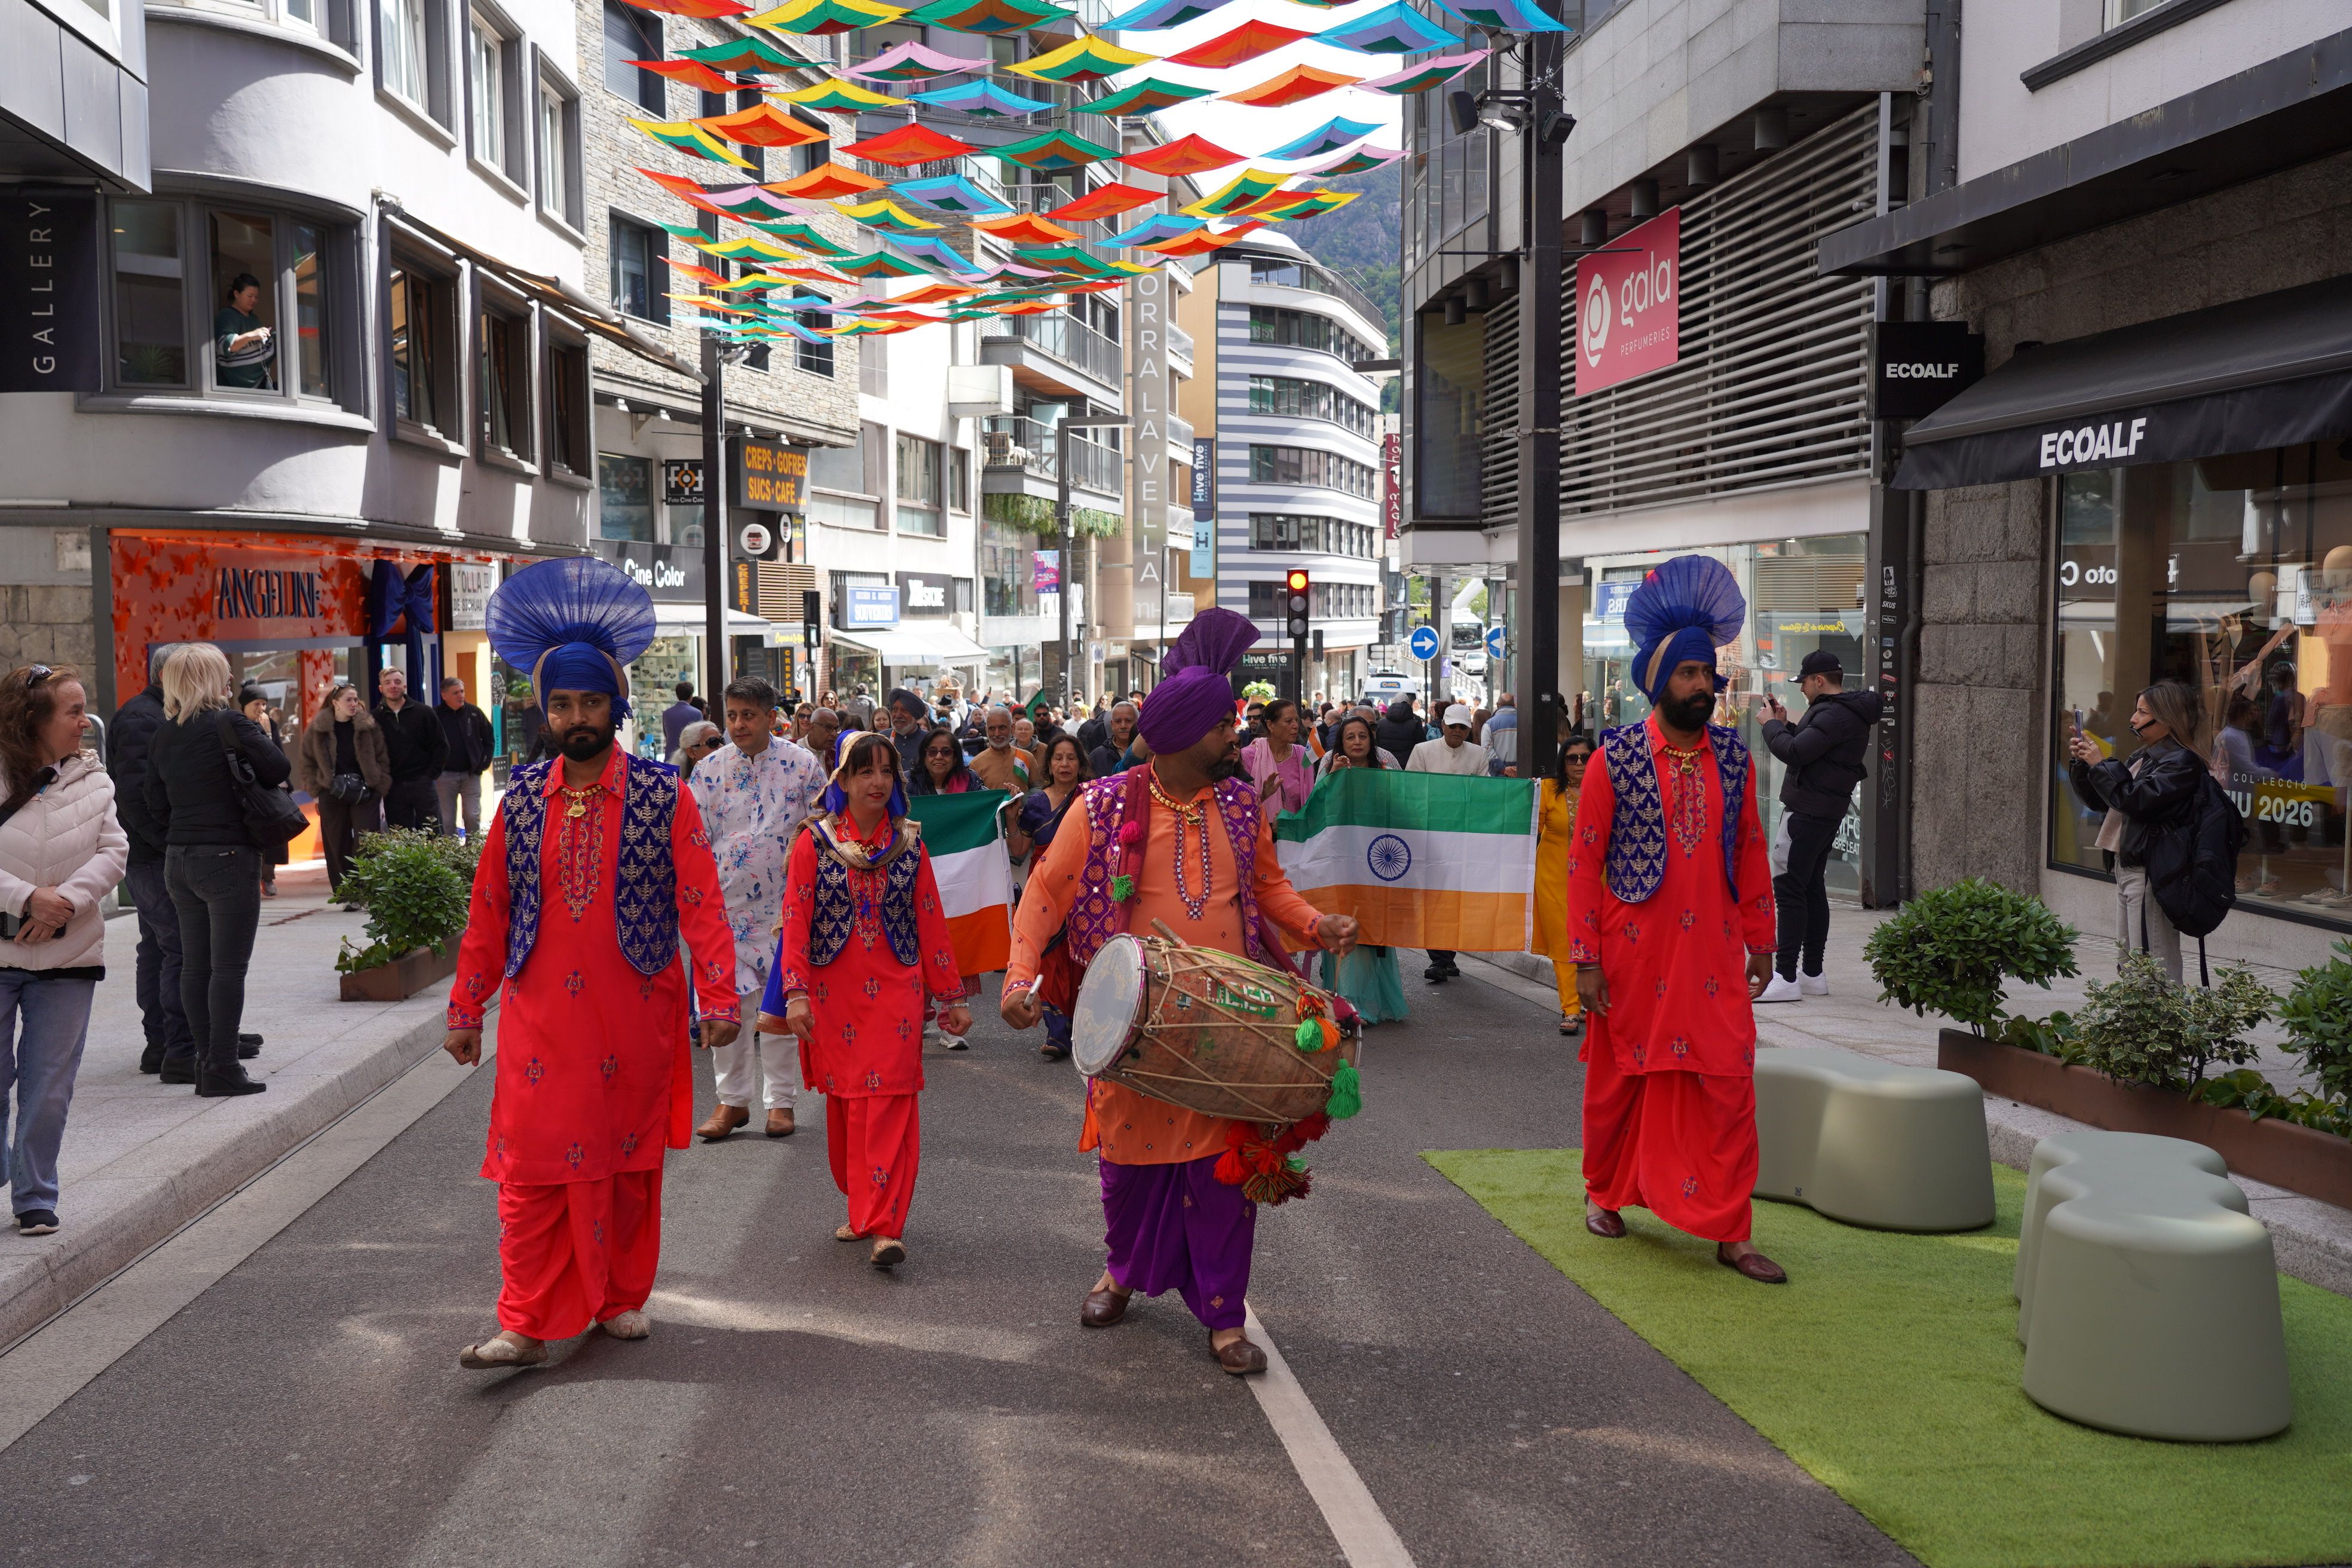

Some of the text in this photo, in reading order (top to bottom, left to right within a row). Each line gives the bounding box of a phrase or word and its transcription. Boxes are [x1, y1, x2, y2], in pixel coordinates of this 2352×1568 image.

[29, 201, 56, 374] GALLERY
[1621, 250, 1671, 329] gala
[1620, 326, 1671, 357] PERFUMERIES
[1886, 363, 1959, 378] ECOALF
[1139, 392, 1159, 440] LA
[2039, 417, 2146, 468] ECOALF
[745, 445, 807, 477] CREPS GOFRES
[748, 476, 796, 505] SUCS CAFÉ
[1140, 454, 1160, 582] VELLA
[654, 559, 686, 588] Color
[219, 567, 323, 620] ANGELINE
[1243, 654, 1266, 664] Hive
[2258, 795, 2313, 828] 2026
